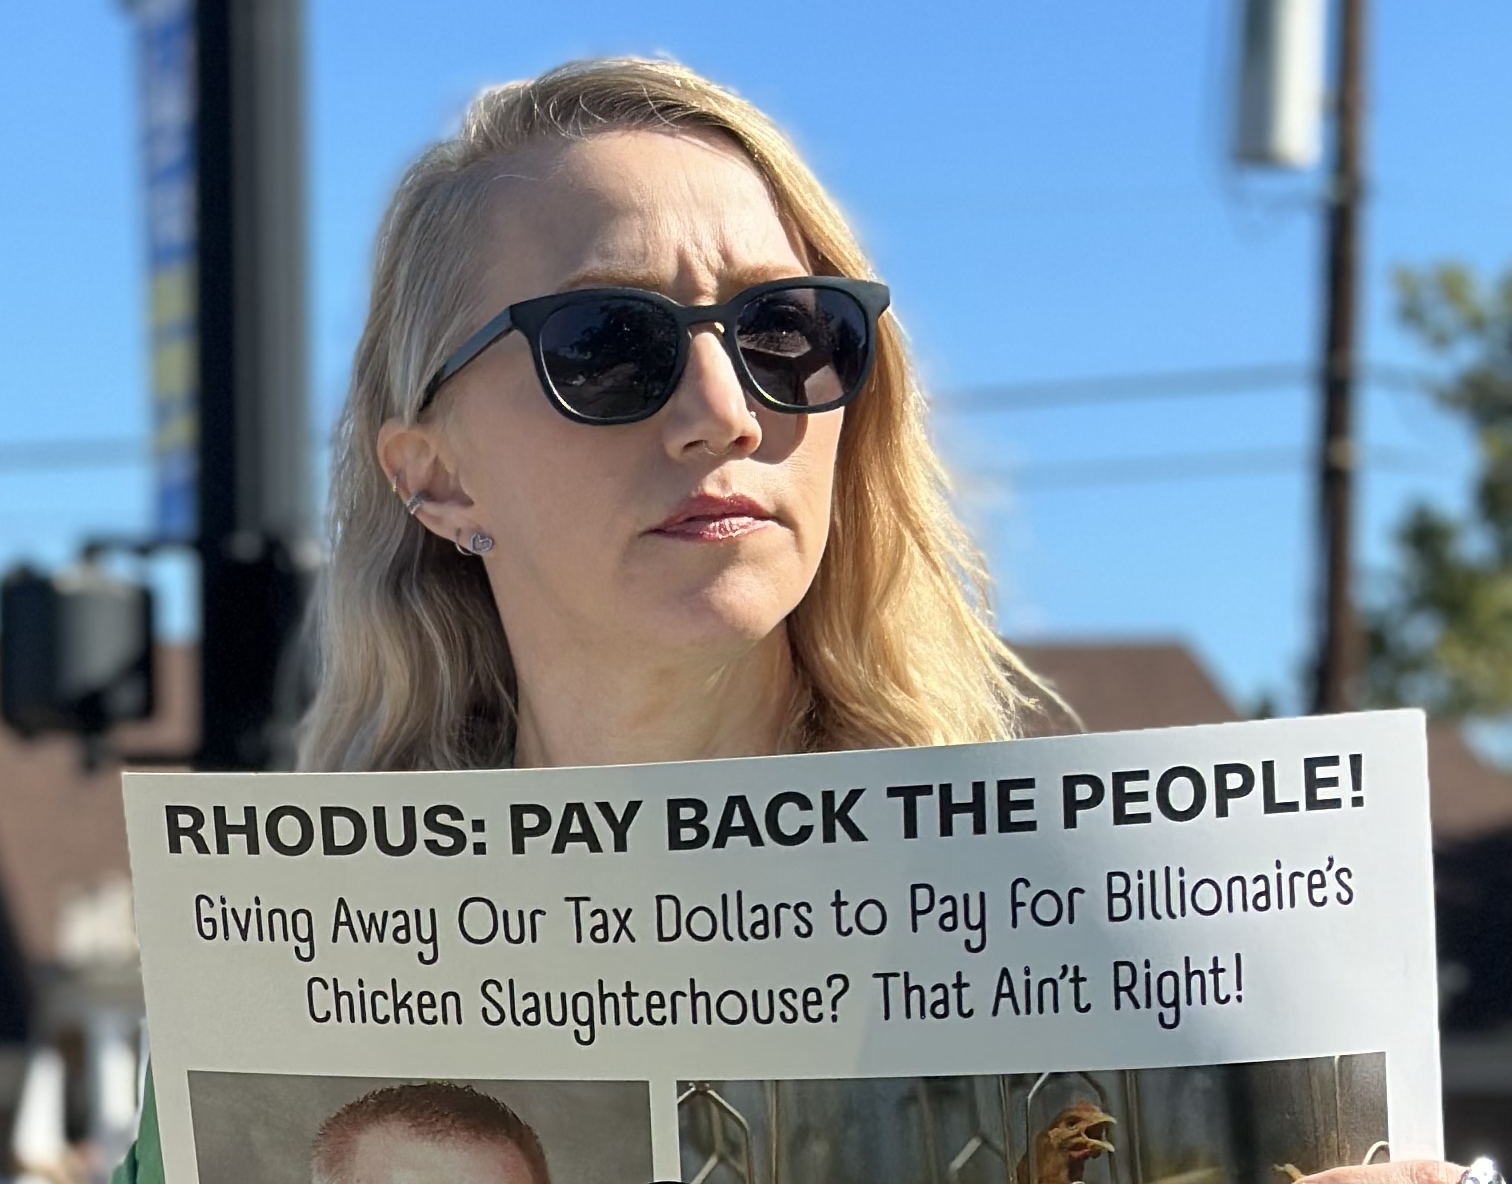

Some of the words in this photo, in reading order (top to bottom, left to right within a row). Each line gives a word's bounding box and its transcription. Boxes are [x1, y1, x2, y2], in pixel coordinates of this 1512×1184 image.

[165, 804, 486, 857] RHODUS:
[510, 800, 643, 855] PAY
[667, 788, 868, 851] BACK
[886, 778, 1037, 839] THE
[1062, 754, 1364, 829] PEOPLE!
[195, 894, 315, 962] Giving
[332, 897, 438, 965] Away
[458, 897, 546, 945] Our
[564, 895, 636, 944] Tax
[655, 890, 813, 942] Dollars
[830, 889, 887, 937] to
[910, 883, 986, 953] Pay
[1011, 877, 1085, 929] for
[1107, 856, 1353, 922] Billionaire's
[307, 977, 462, 1025] Chicken
[481, 974, 849, 1045] Slaughterhouse?
[872, 971, 974, 1021] That
[992, 964, 1091, 1017] Ain't
[1113, 953, 1242, 1029] Right!
